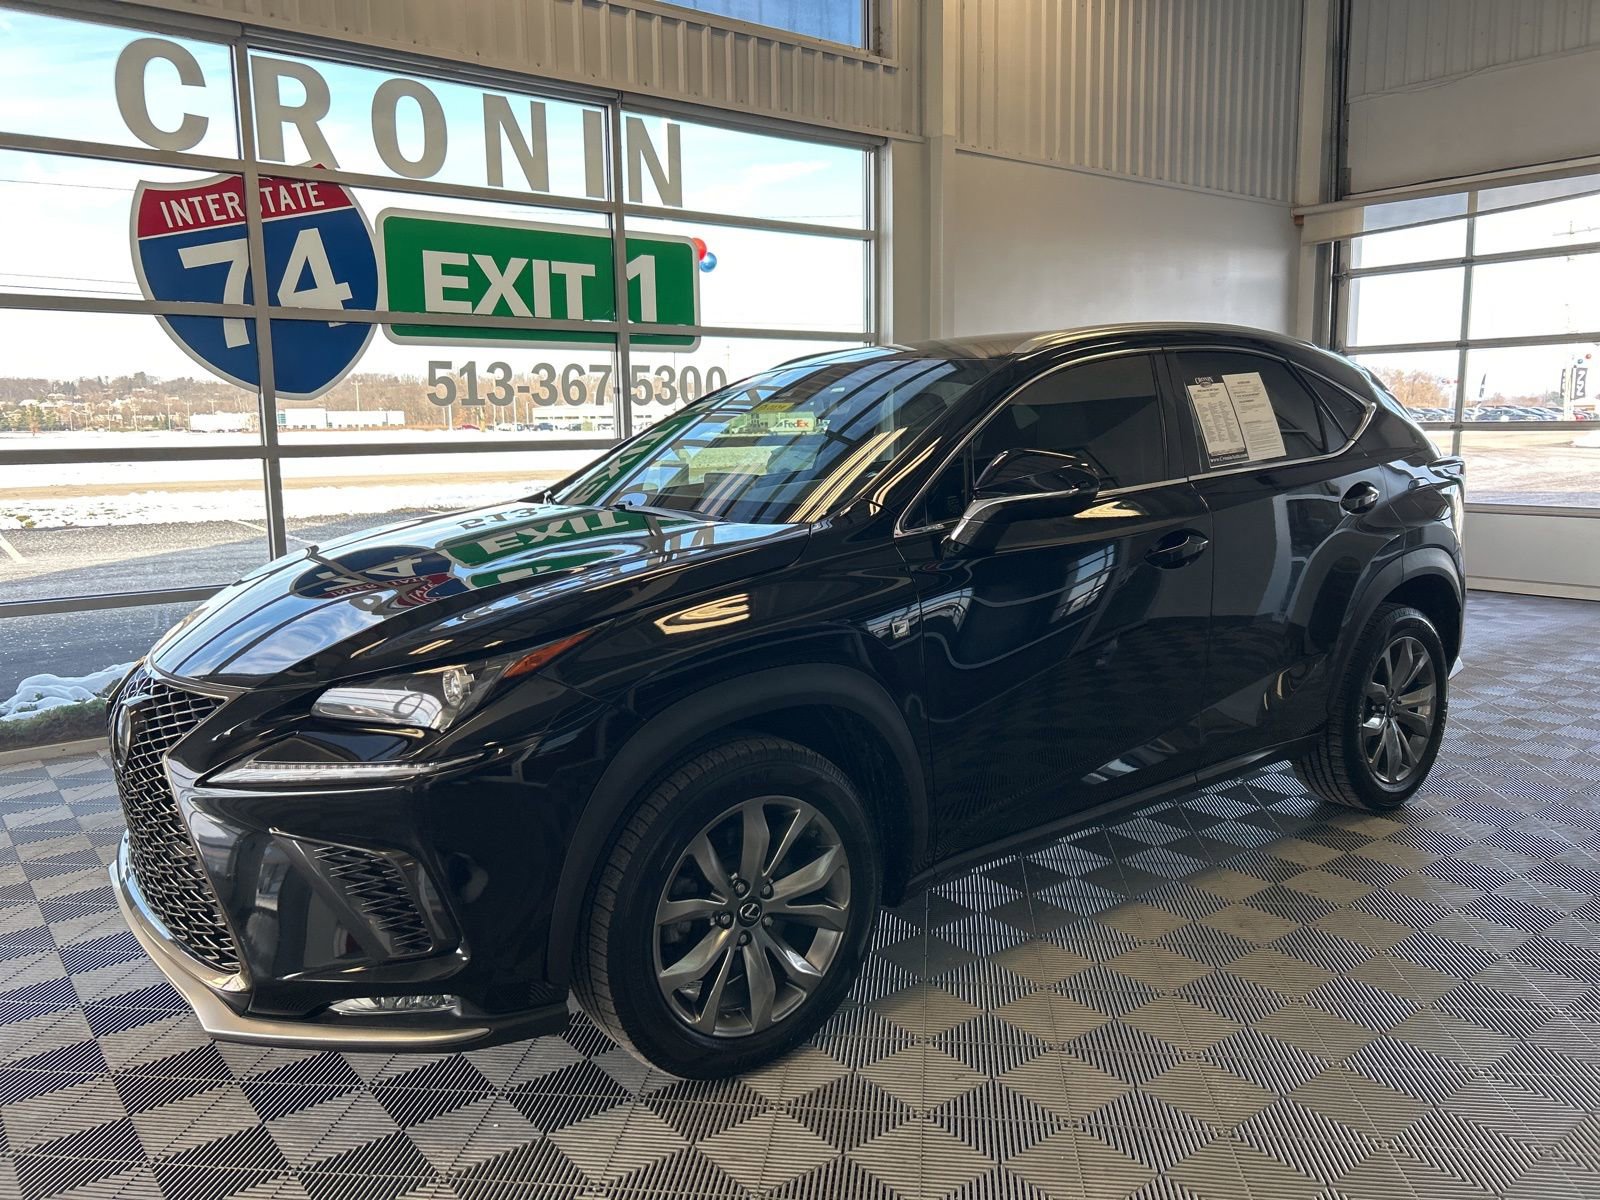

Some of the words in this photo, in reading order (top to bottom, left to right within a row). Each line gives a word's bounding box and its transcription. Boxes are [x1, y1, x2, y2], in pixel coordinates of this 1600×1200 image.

[114, 38, 683, 208] CRONIN
[160, 182, 325, 228] INTERTATE
[177, 227, 353, 349] 74
[422, 250, 596, 320] EXIT
[626, 254, 657, 322] 1
[784, 419, 809, 429] FedEx
